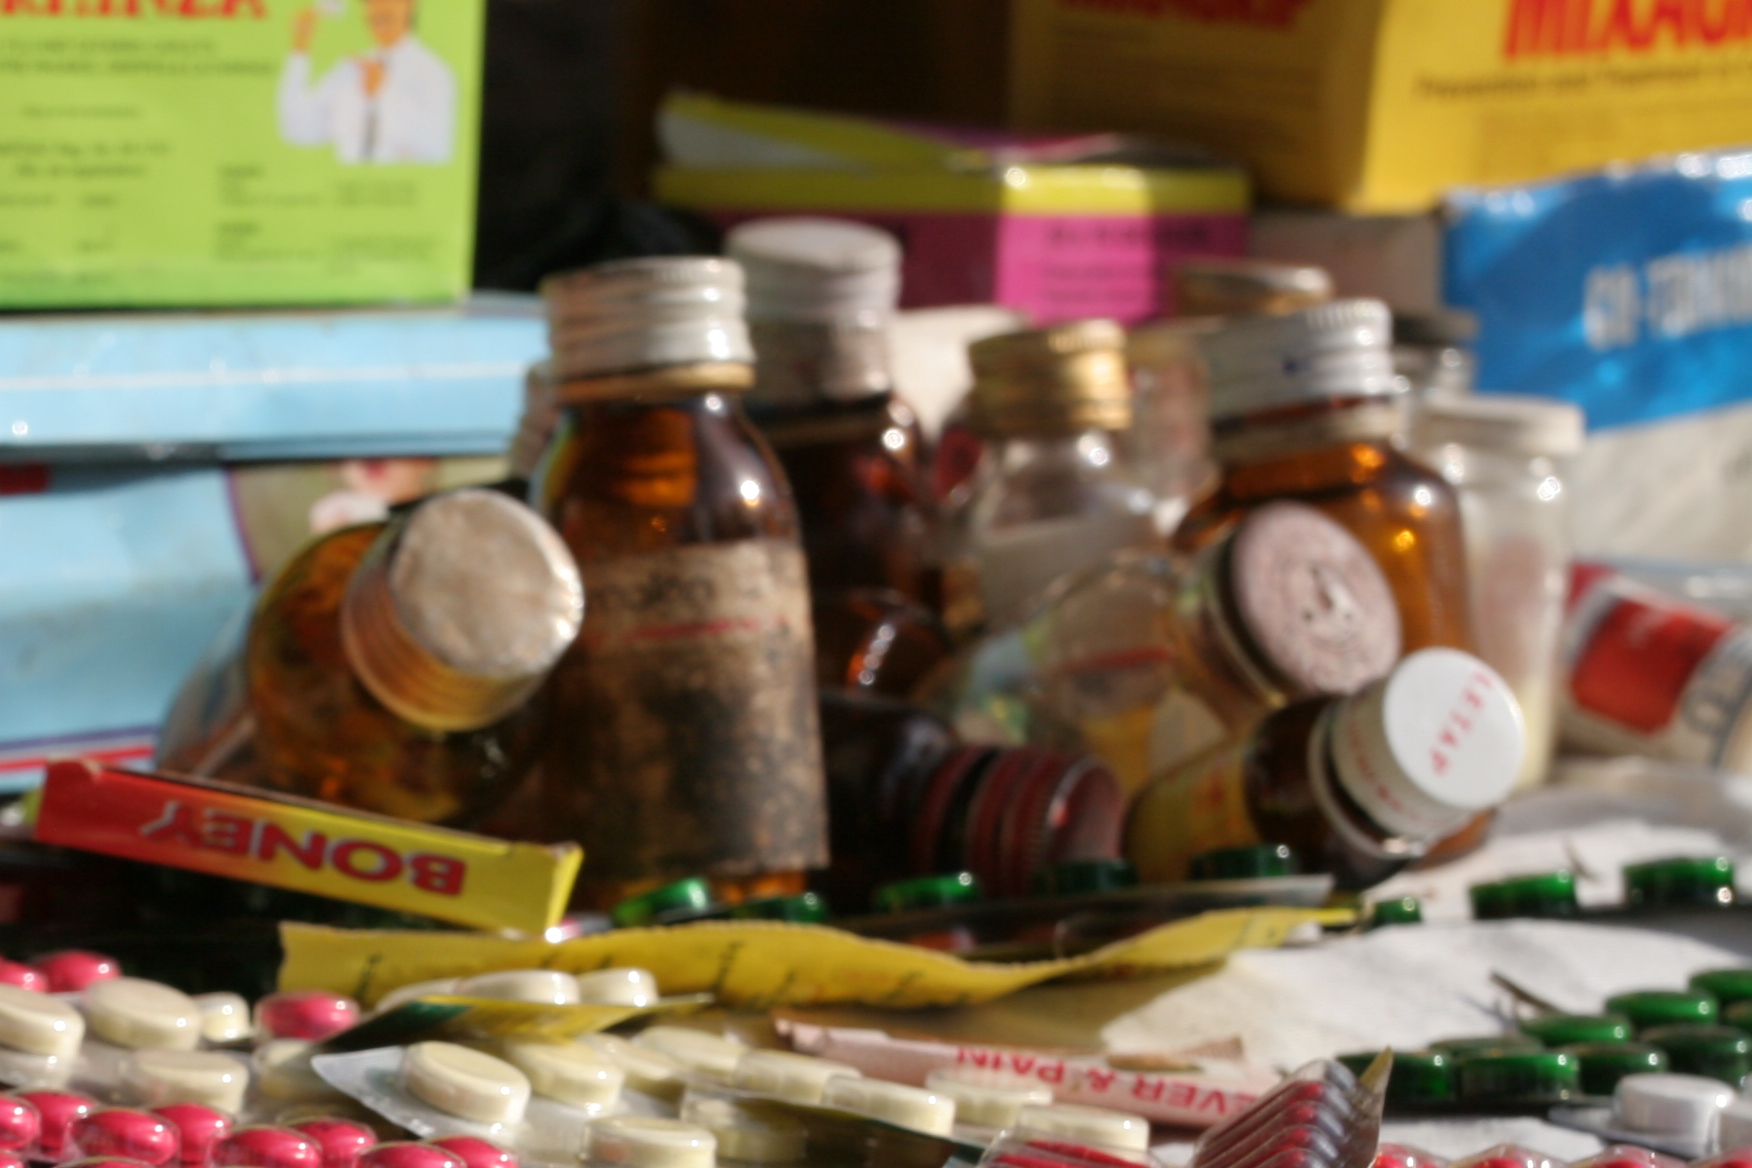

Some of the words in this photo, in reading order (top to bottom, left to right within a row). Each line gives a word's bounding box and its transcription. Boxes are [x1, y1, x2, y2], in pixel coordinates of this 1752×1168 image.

[142, 800, 467, 899] BONEY
[954, 1046, 1065, 1084] PAIN
[1085, 1069, 1117, 1093] &
